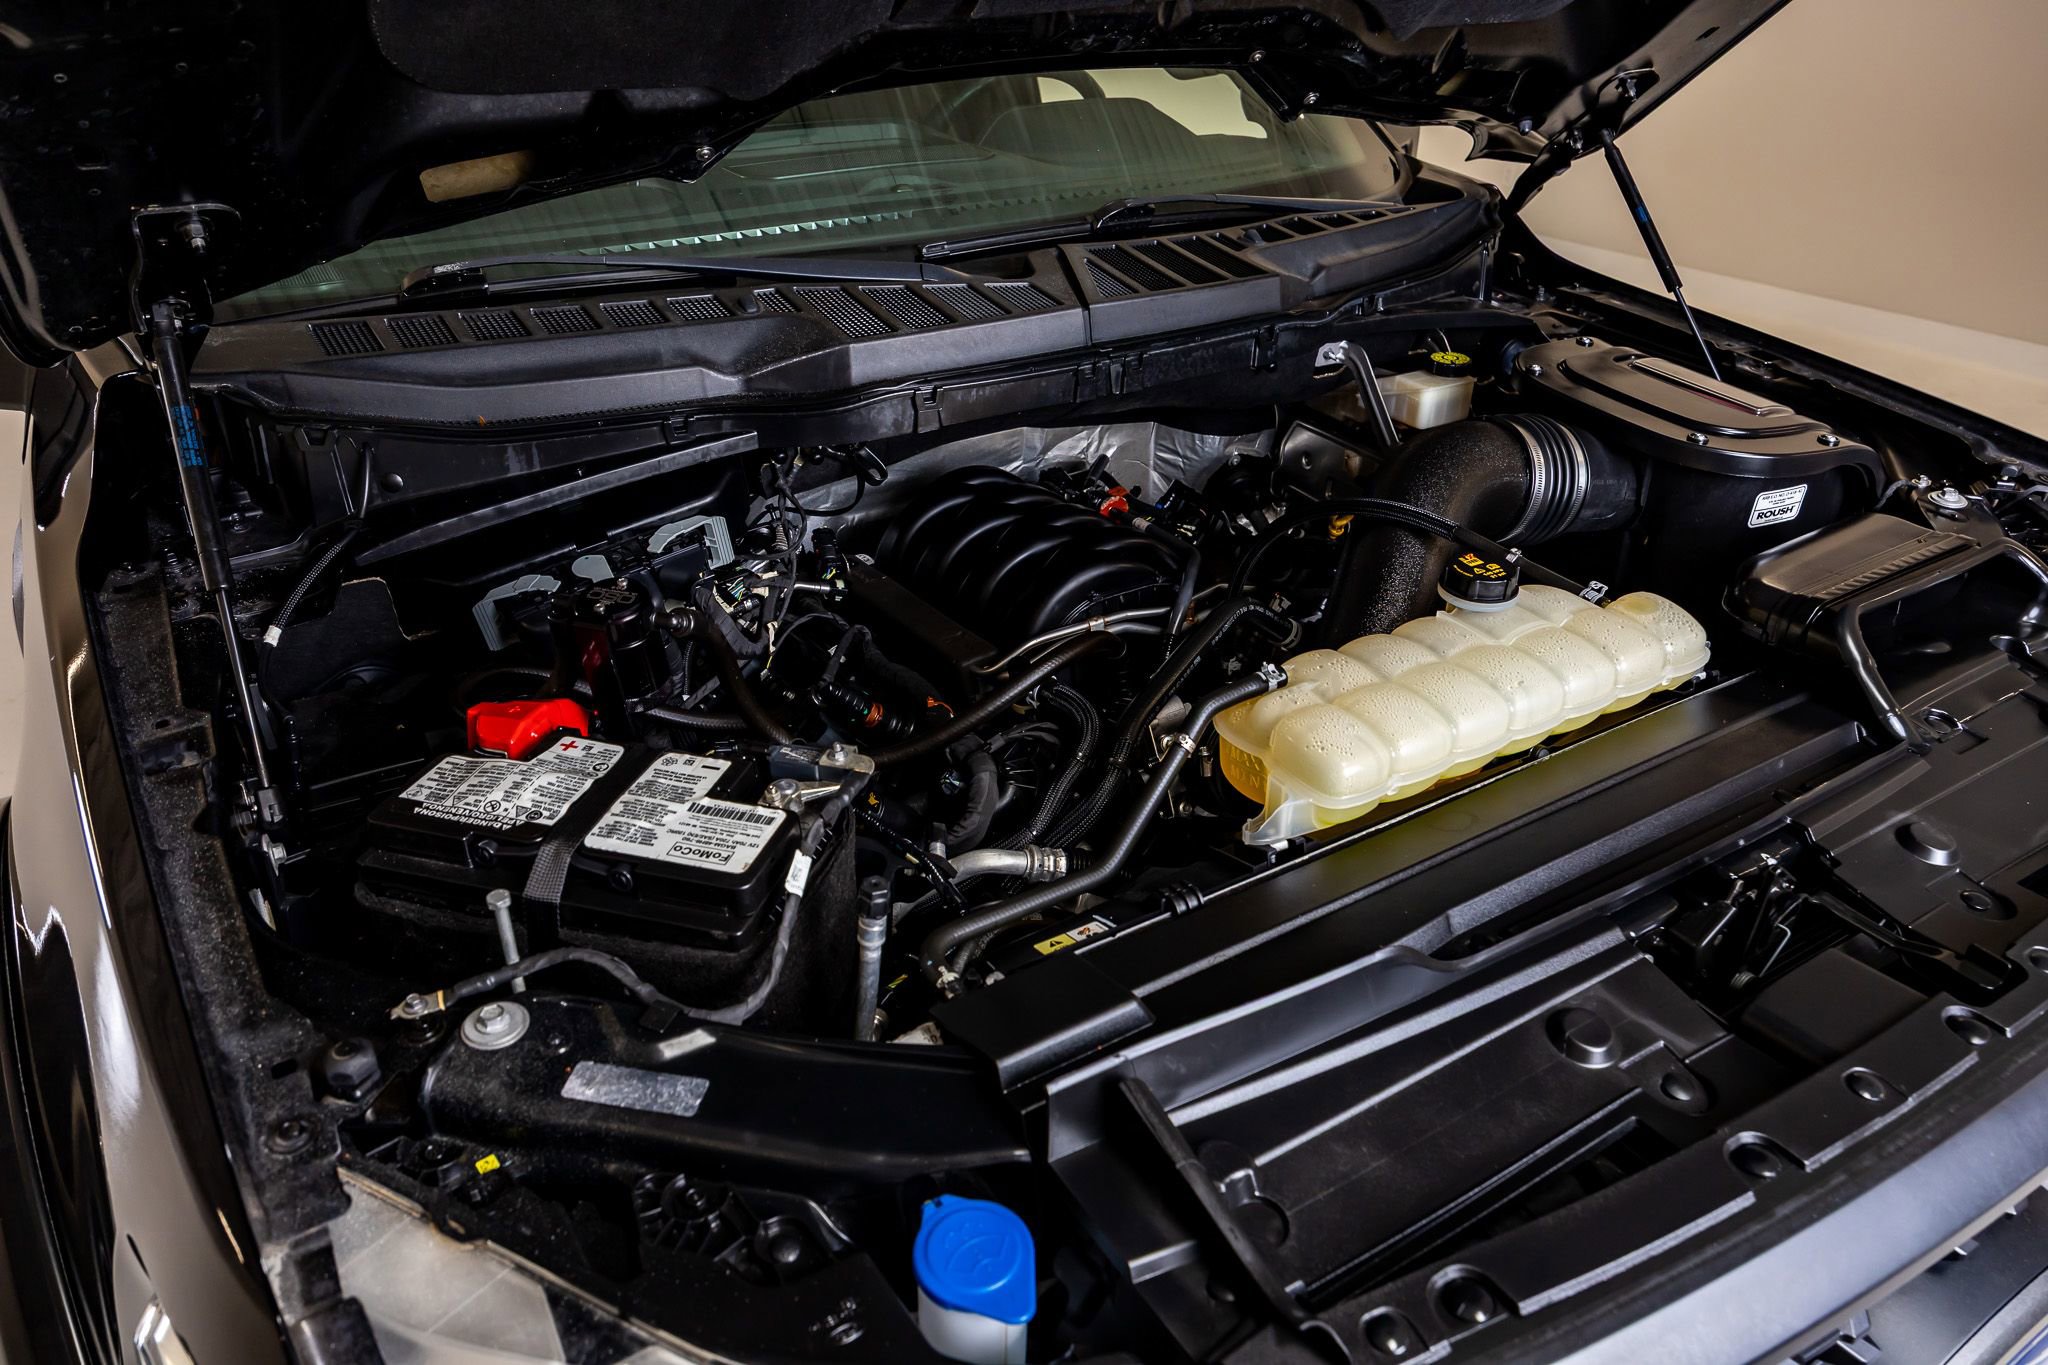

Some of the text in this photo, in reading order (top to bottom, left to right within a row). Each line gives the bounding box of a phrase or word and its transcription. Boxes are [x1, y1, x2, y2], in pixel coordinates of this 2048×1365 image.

[1757, 506, 1794, 520] ROUSH
[420, 808, 502, 829] DANGER/POISON
[429, 803, 515, 825] PELIGRO/VENENO
[673, 844, 731, 862] FoMoCo
